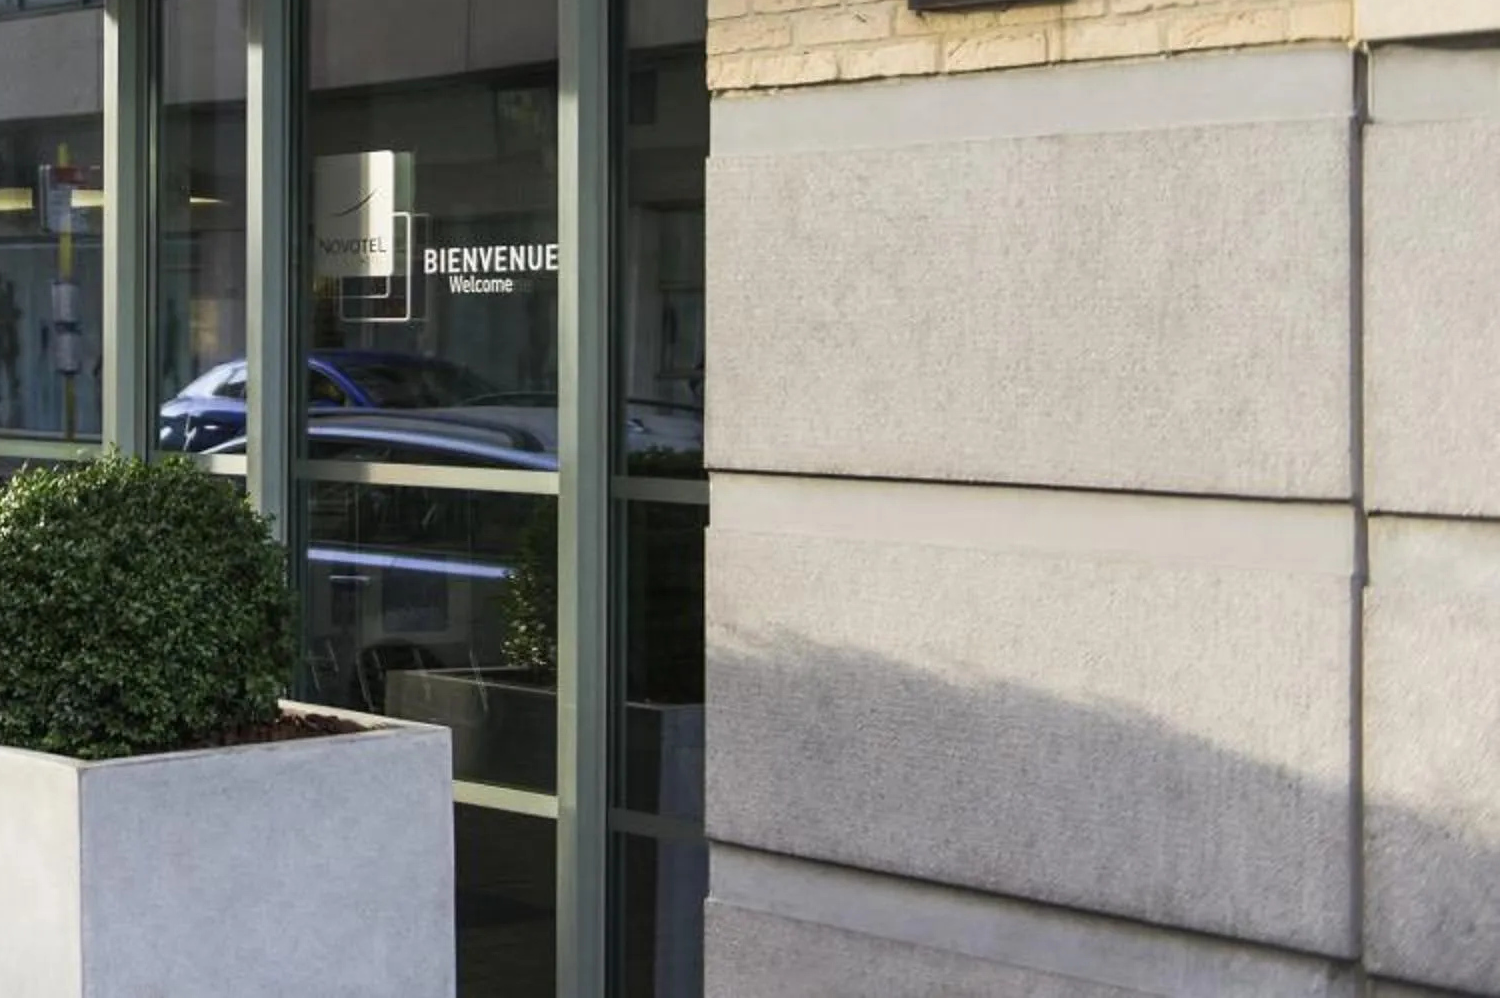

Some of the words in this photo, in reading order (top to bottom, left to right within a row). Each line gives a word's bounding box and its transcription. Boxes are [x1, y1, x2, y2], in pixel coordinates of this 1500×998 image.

[319, 236, 388, 254] NOVOTEL
[423, 244, 559, 274] BIENVENUE
[449, 276, 513, 293] Welcome
